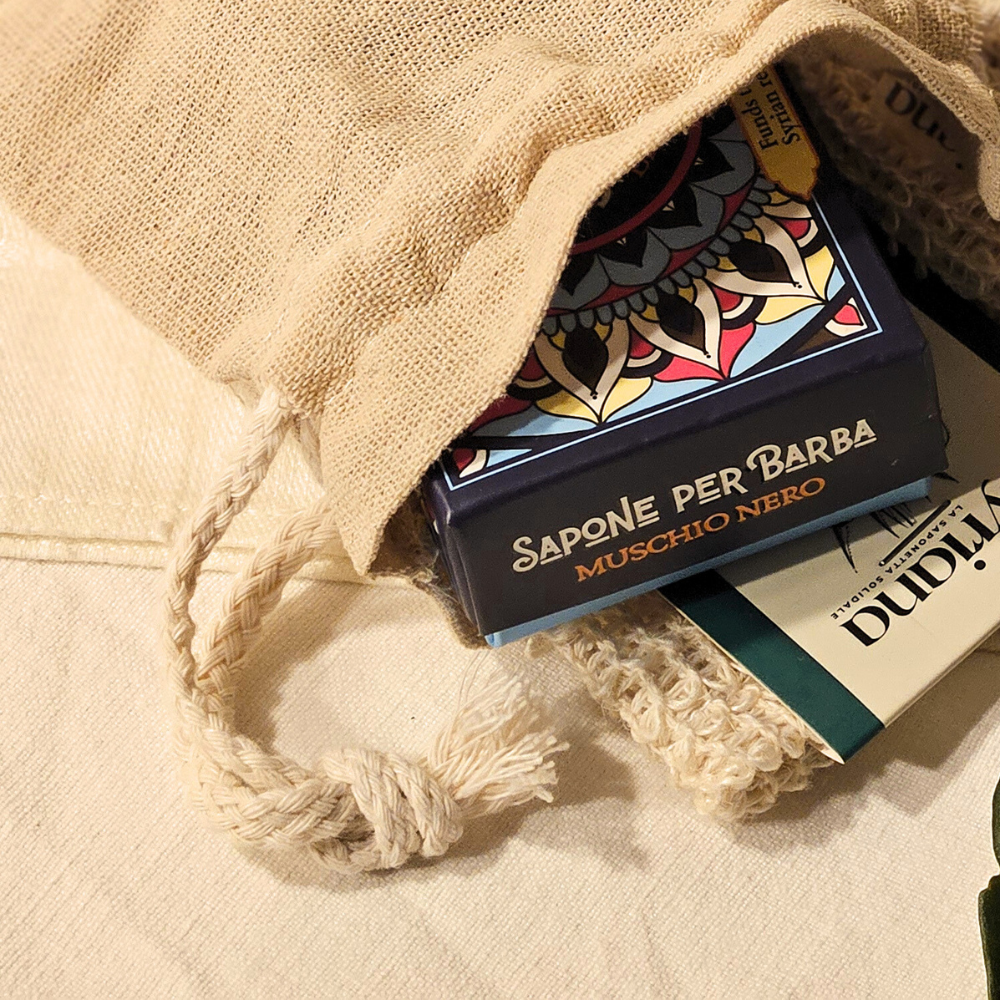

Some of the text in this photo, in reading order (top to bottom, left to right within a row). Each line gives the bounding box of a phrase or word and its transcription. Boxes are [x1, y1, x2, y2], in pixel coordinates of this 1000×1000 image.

[741, 98, 779, 150] Funds
[766, 90, 802, 145] Syrian
[575, 477, 826, 582] MUSCHIO NERO
[830, 504, 964, 620] LA SAPONETTA SOLIDALE
